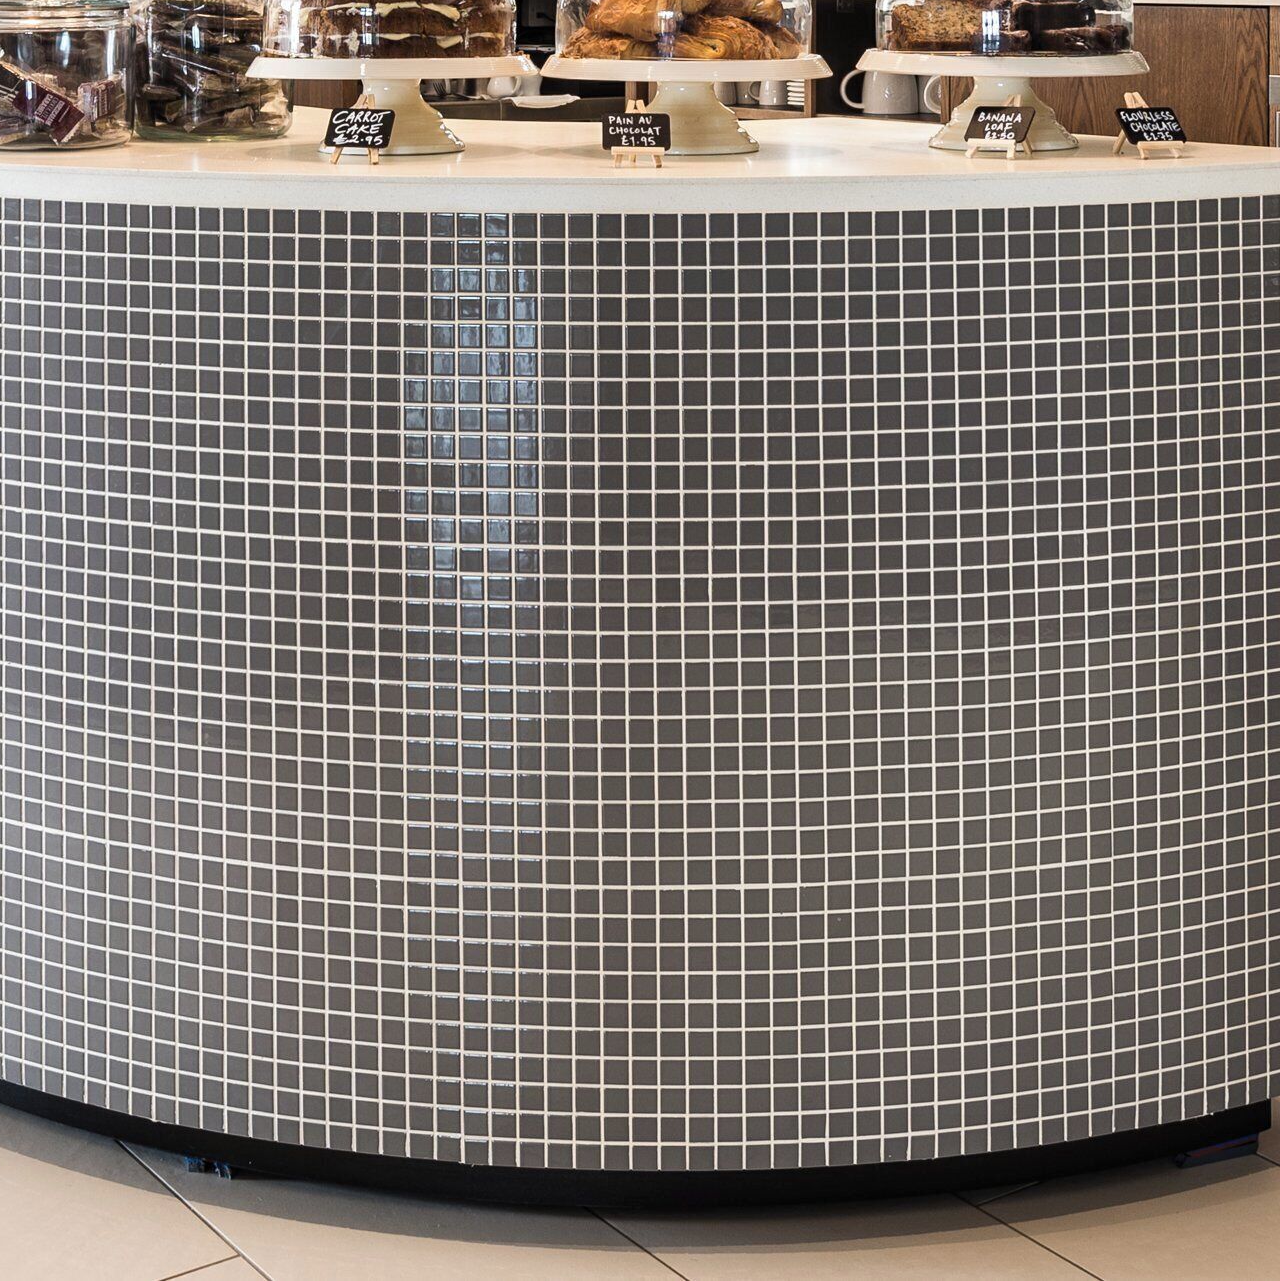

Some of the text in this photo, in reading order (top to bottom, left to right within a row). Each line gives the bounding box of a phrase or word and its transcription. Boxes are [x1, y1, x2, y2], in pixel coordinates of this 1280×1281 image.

[332, 110, 391, 124] CARROT
[608, 116, 652, 125] PAIN AU
[978, 111, 1022, 123] BANANA
[1120, 111, 1175, 122] FLOURLESS
[334, 123, 383, 135] CAKE
[609, 126, 662, 135] CHOCOLAT
[984, 122, 1013, 133] LOAF
[1130, 121, 1181, 132] CHOCOLATE
[332, 134, 383, 146] £2.95
[621, 135, 656, 146] £1.95
